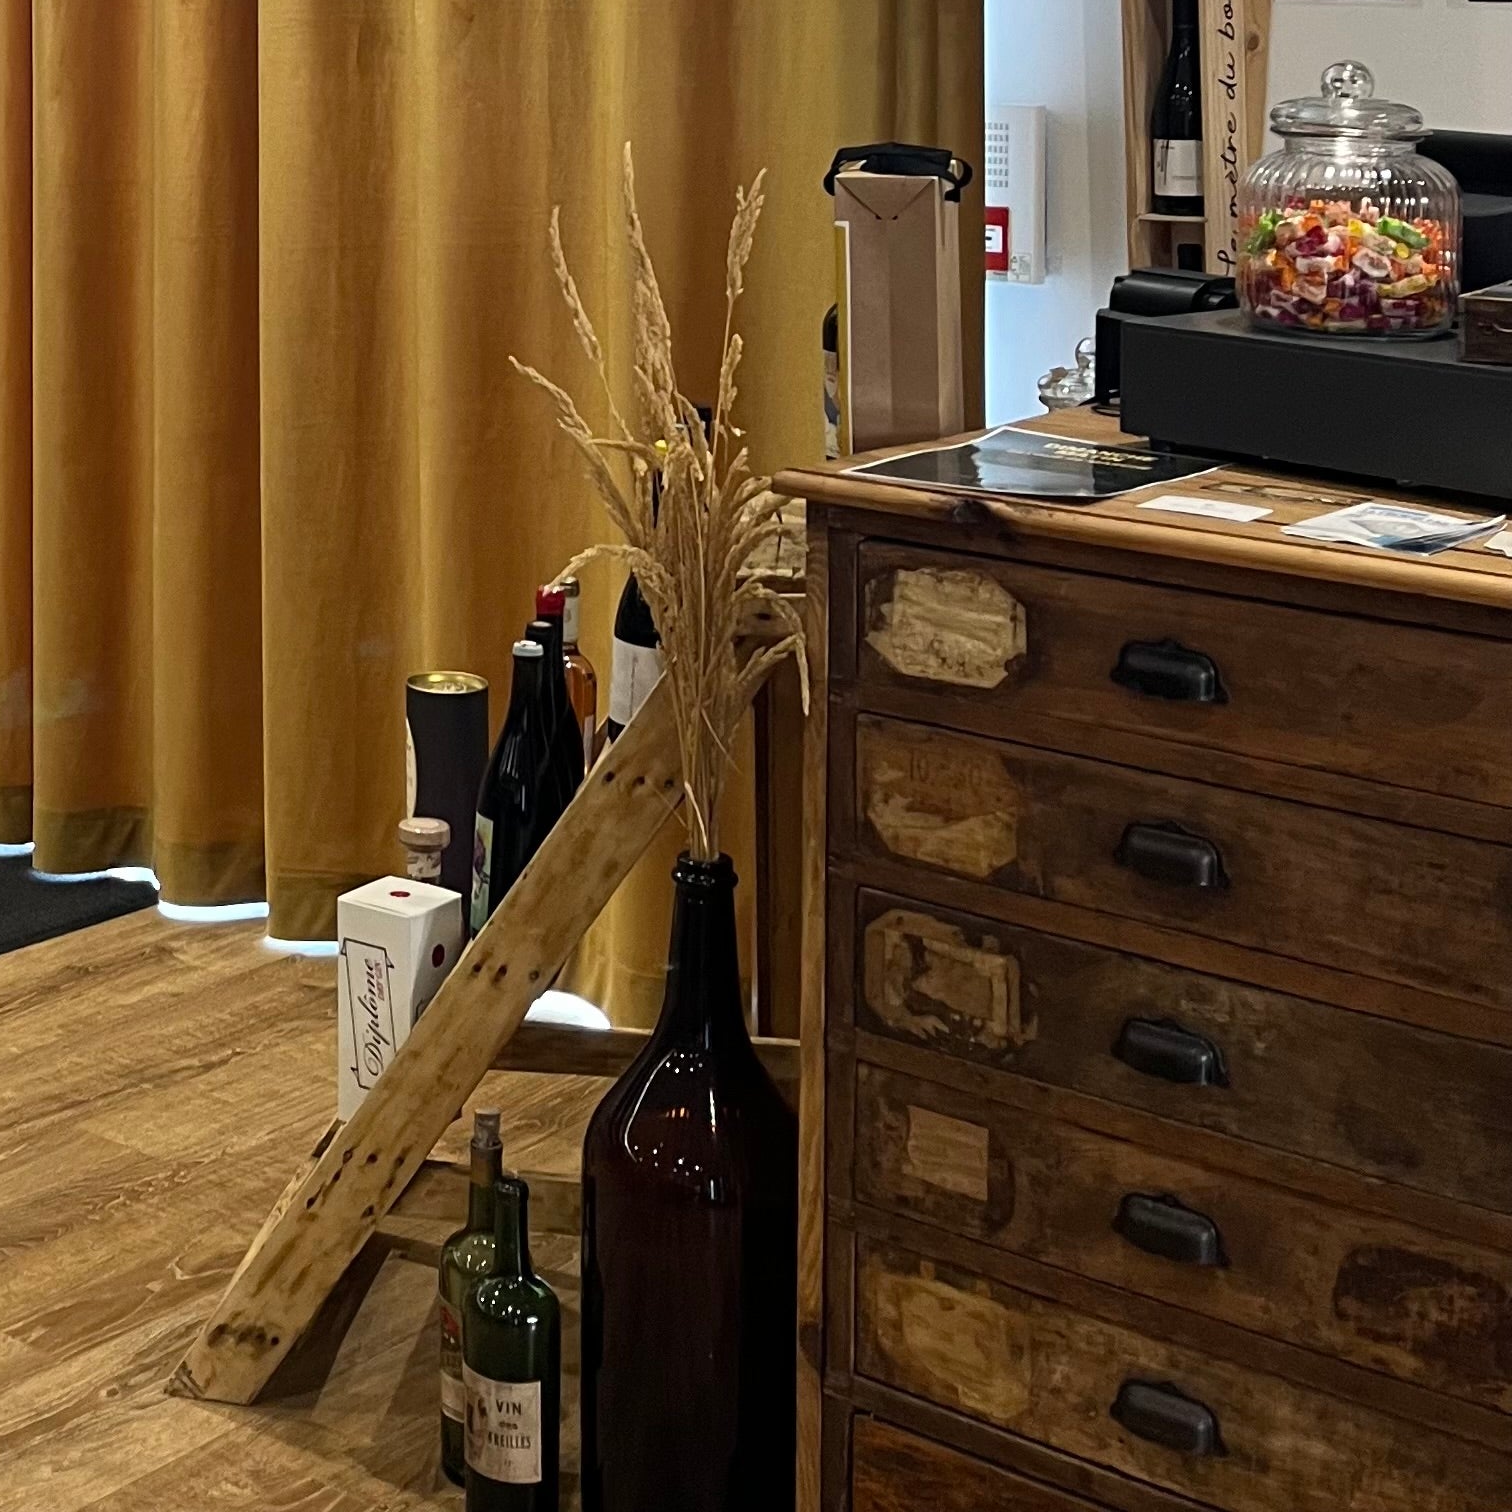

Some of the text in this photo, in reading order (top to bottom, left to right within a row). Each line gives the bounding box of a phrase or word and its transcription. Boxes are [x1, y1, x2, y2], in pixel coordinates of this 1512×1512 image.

[1218, 51, 1237, 100] du
[357, 958, 391, 1076] Diplôme
[496, 1399, 522, 1416] VIN
